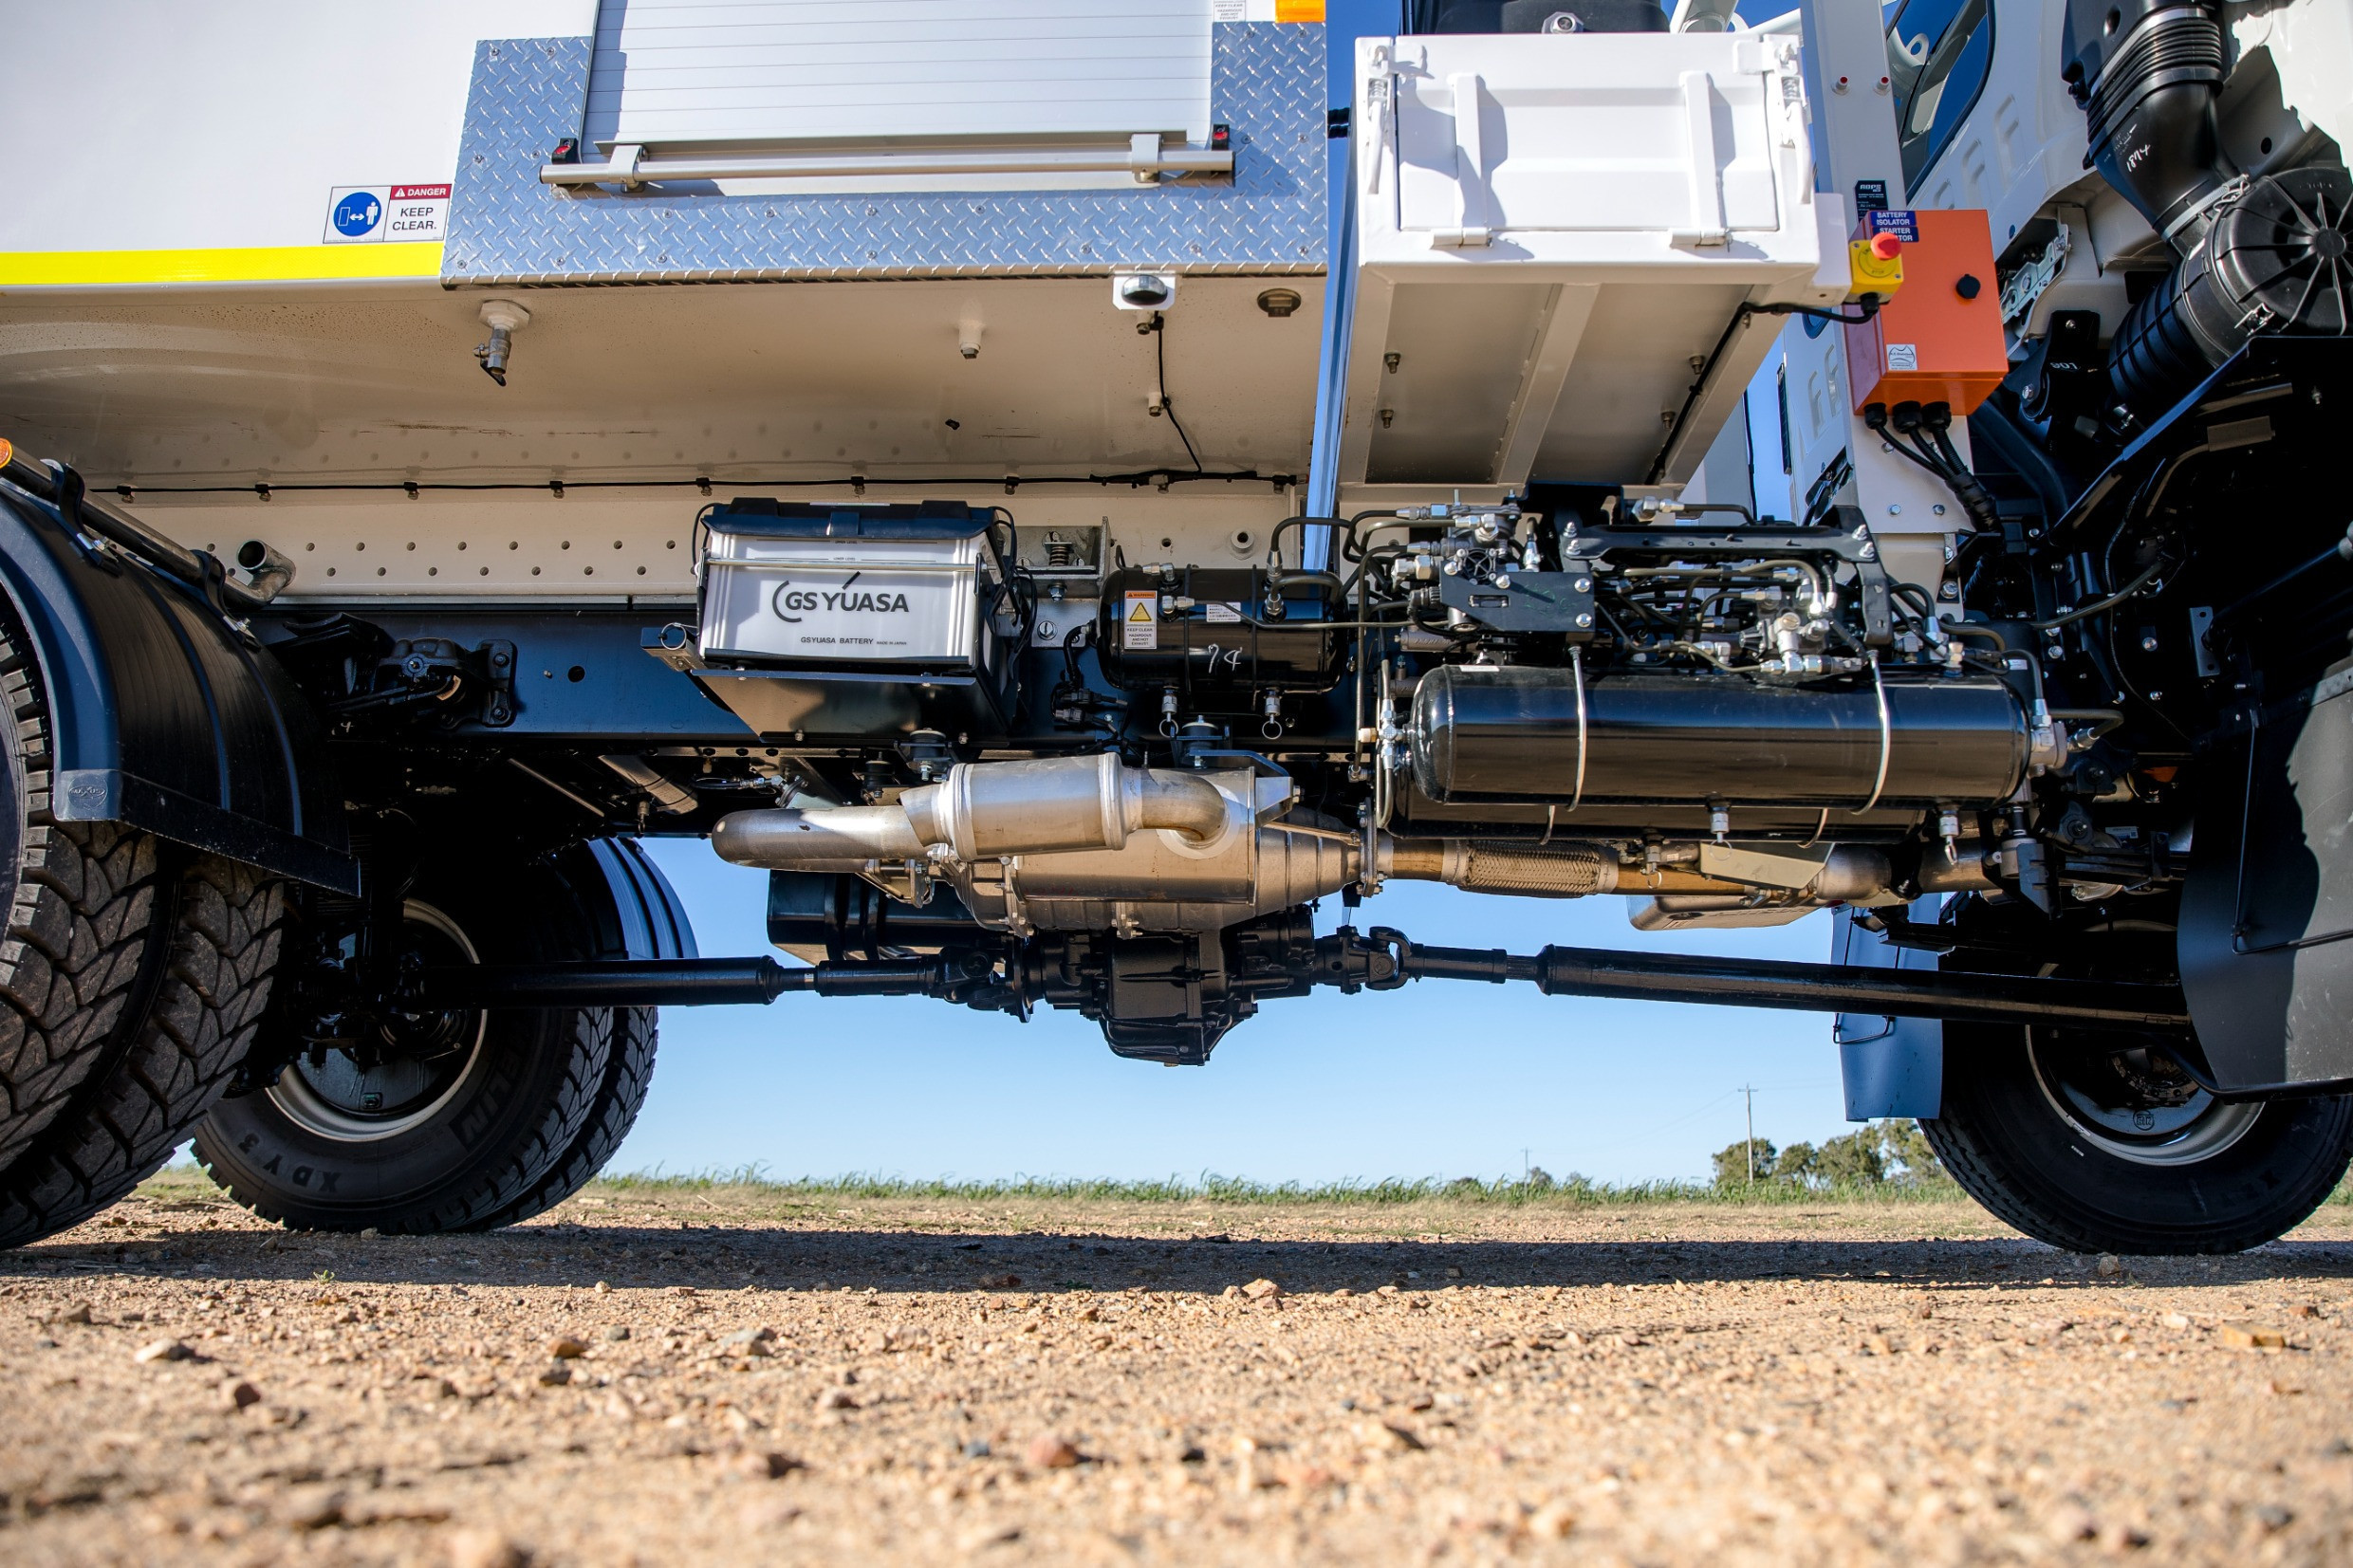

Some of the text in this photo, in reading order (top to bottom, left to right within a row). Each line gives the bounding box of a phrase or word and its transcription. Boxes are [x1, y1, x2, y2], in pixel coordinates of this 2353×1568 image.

[407, 188, 446, 196] DANGER
[400, 207, 434, 217] KEEP
[392, 220, 436, 231] CLEAR.
